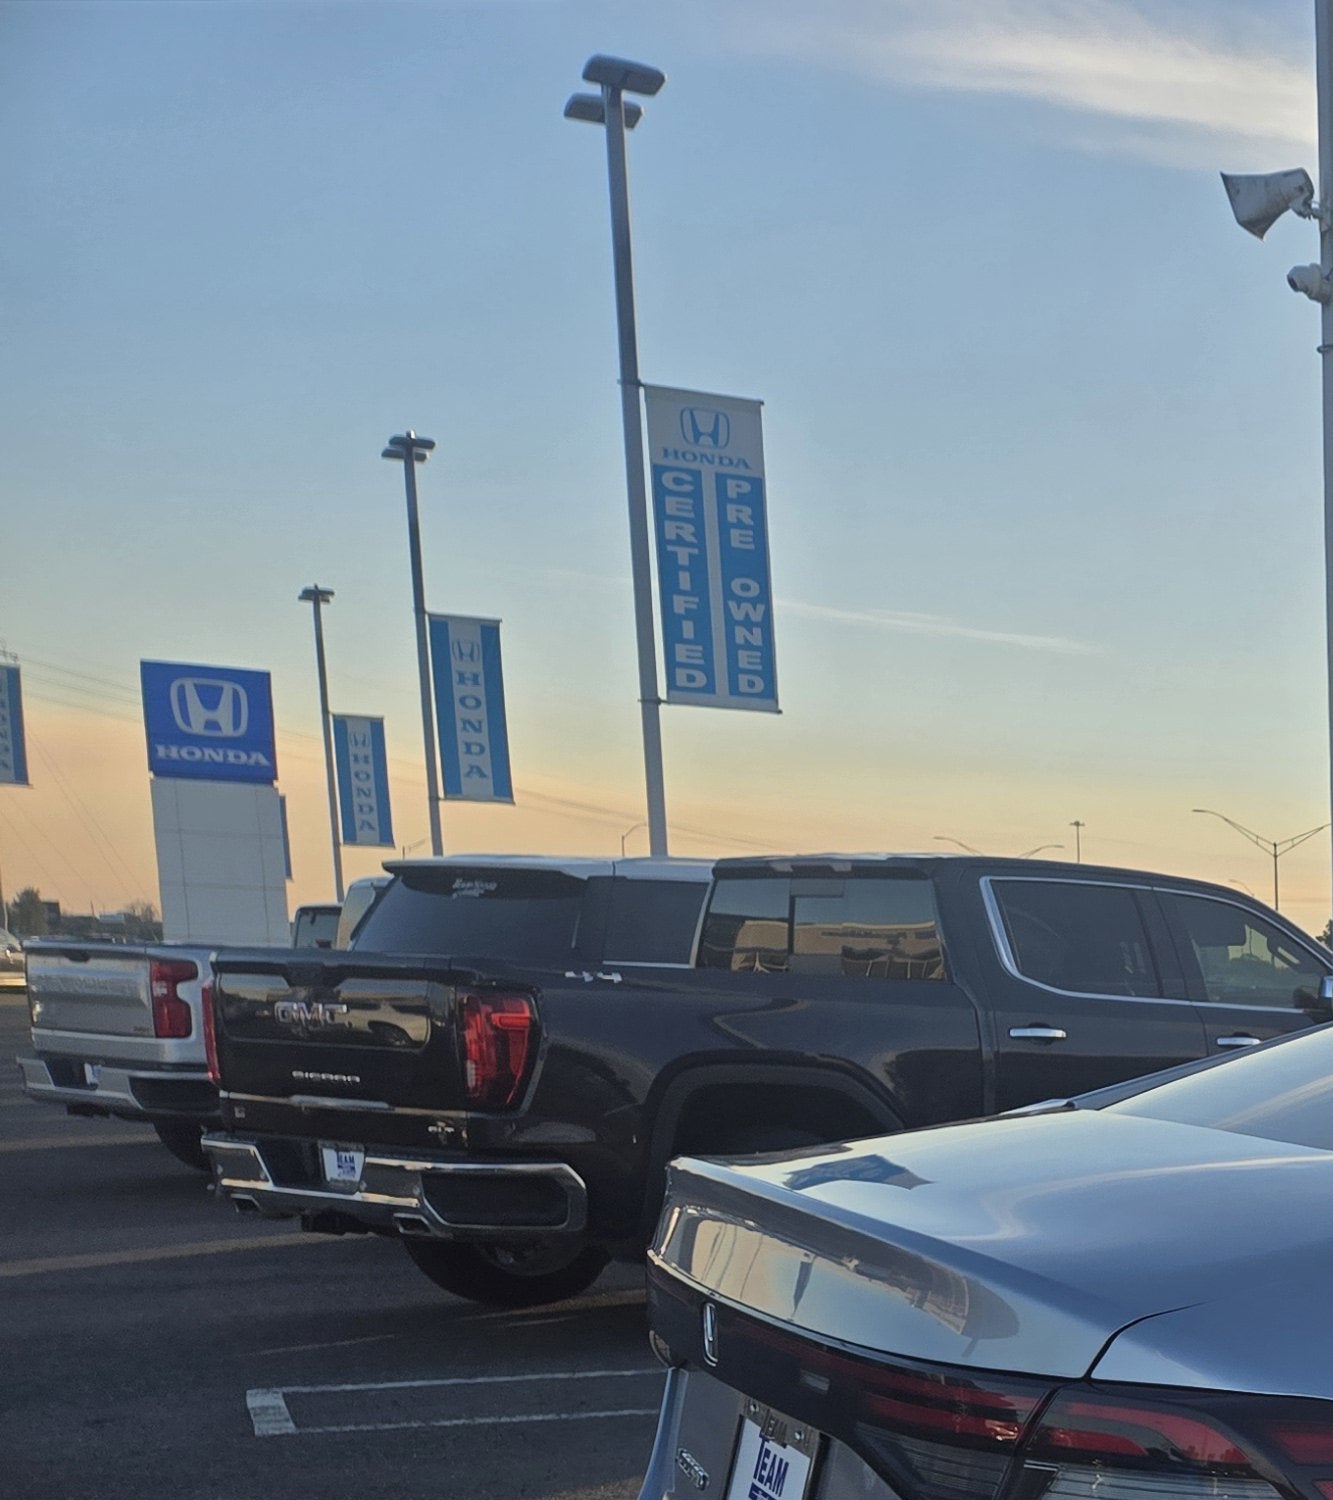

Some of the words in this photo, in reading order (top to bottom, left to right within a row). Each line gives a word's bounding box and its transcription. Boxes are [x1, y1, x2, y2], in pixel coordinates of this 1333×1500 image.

[661, 447, 751, 470] HONDA
[726, 479, 755, 550] PRE
[661, 471, 708, 690] CERTIFIED
[727, 577, 765, 695] OWNED
[154, 744, 270, 767] HONDA
[455, 671, 489, 780] HONDA
[352, 754, 376, 832] HONDA
[753, 1435, 790, 1498] TEAM
